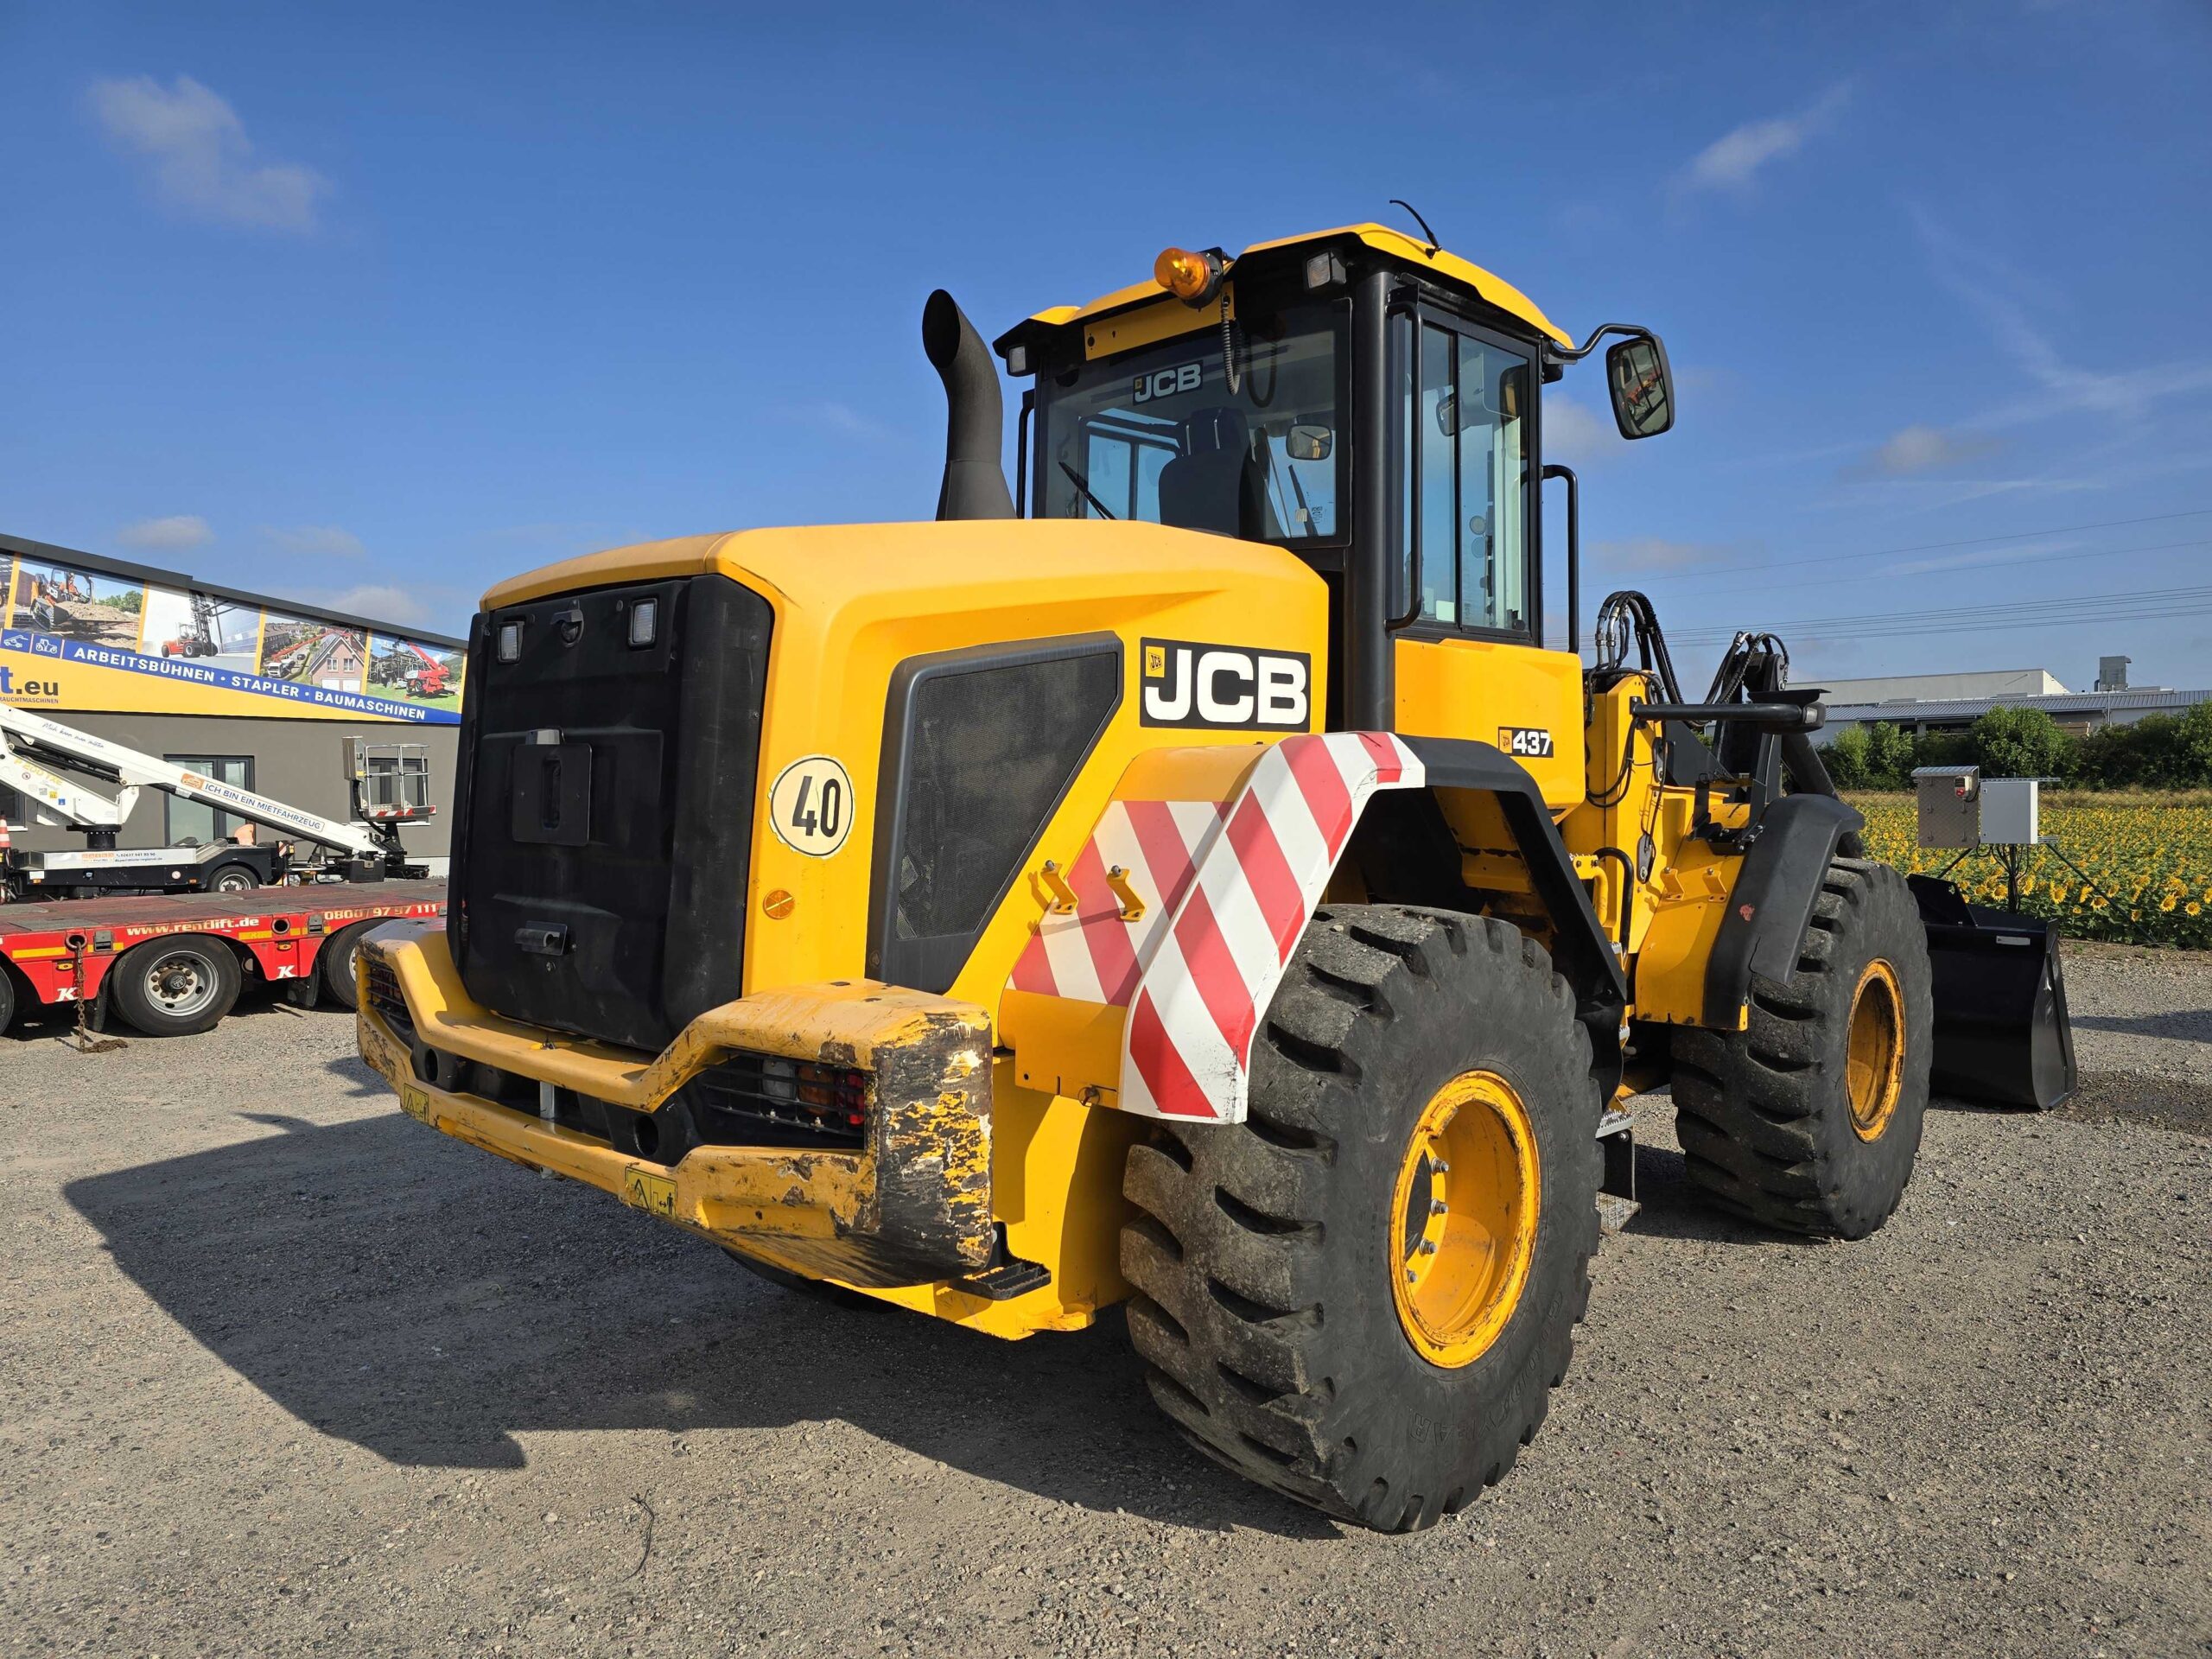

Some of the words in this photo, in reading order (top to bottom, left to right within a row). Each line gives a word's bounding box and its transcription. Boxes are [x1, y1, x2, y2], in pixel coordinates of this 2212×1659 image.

[1135, 364, 1201, 403] JCB
[1148, 652, 1163, 671] JCB
[73, 647, 215, 683] ARBEITSBÜHNEN
[231, 676, 299, 697] STAPLER
[315, 690, 426, 721] BAUMASCHINEN
[1145, 648, 1307, 725] JCB
[1513, 731, 1552, 755] 437
[205, 783, 221, 794] ICH
[223, 790, 239, 801] BIN
[240, 797, 256, 806] EIN
[257, 802, 321, 830] MIETFAHRZEUG
[791, 775, 842, 838] 40
[126, 917, 259, 936] www.rentlift.de
[416, 904, 437, 913] 111
